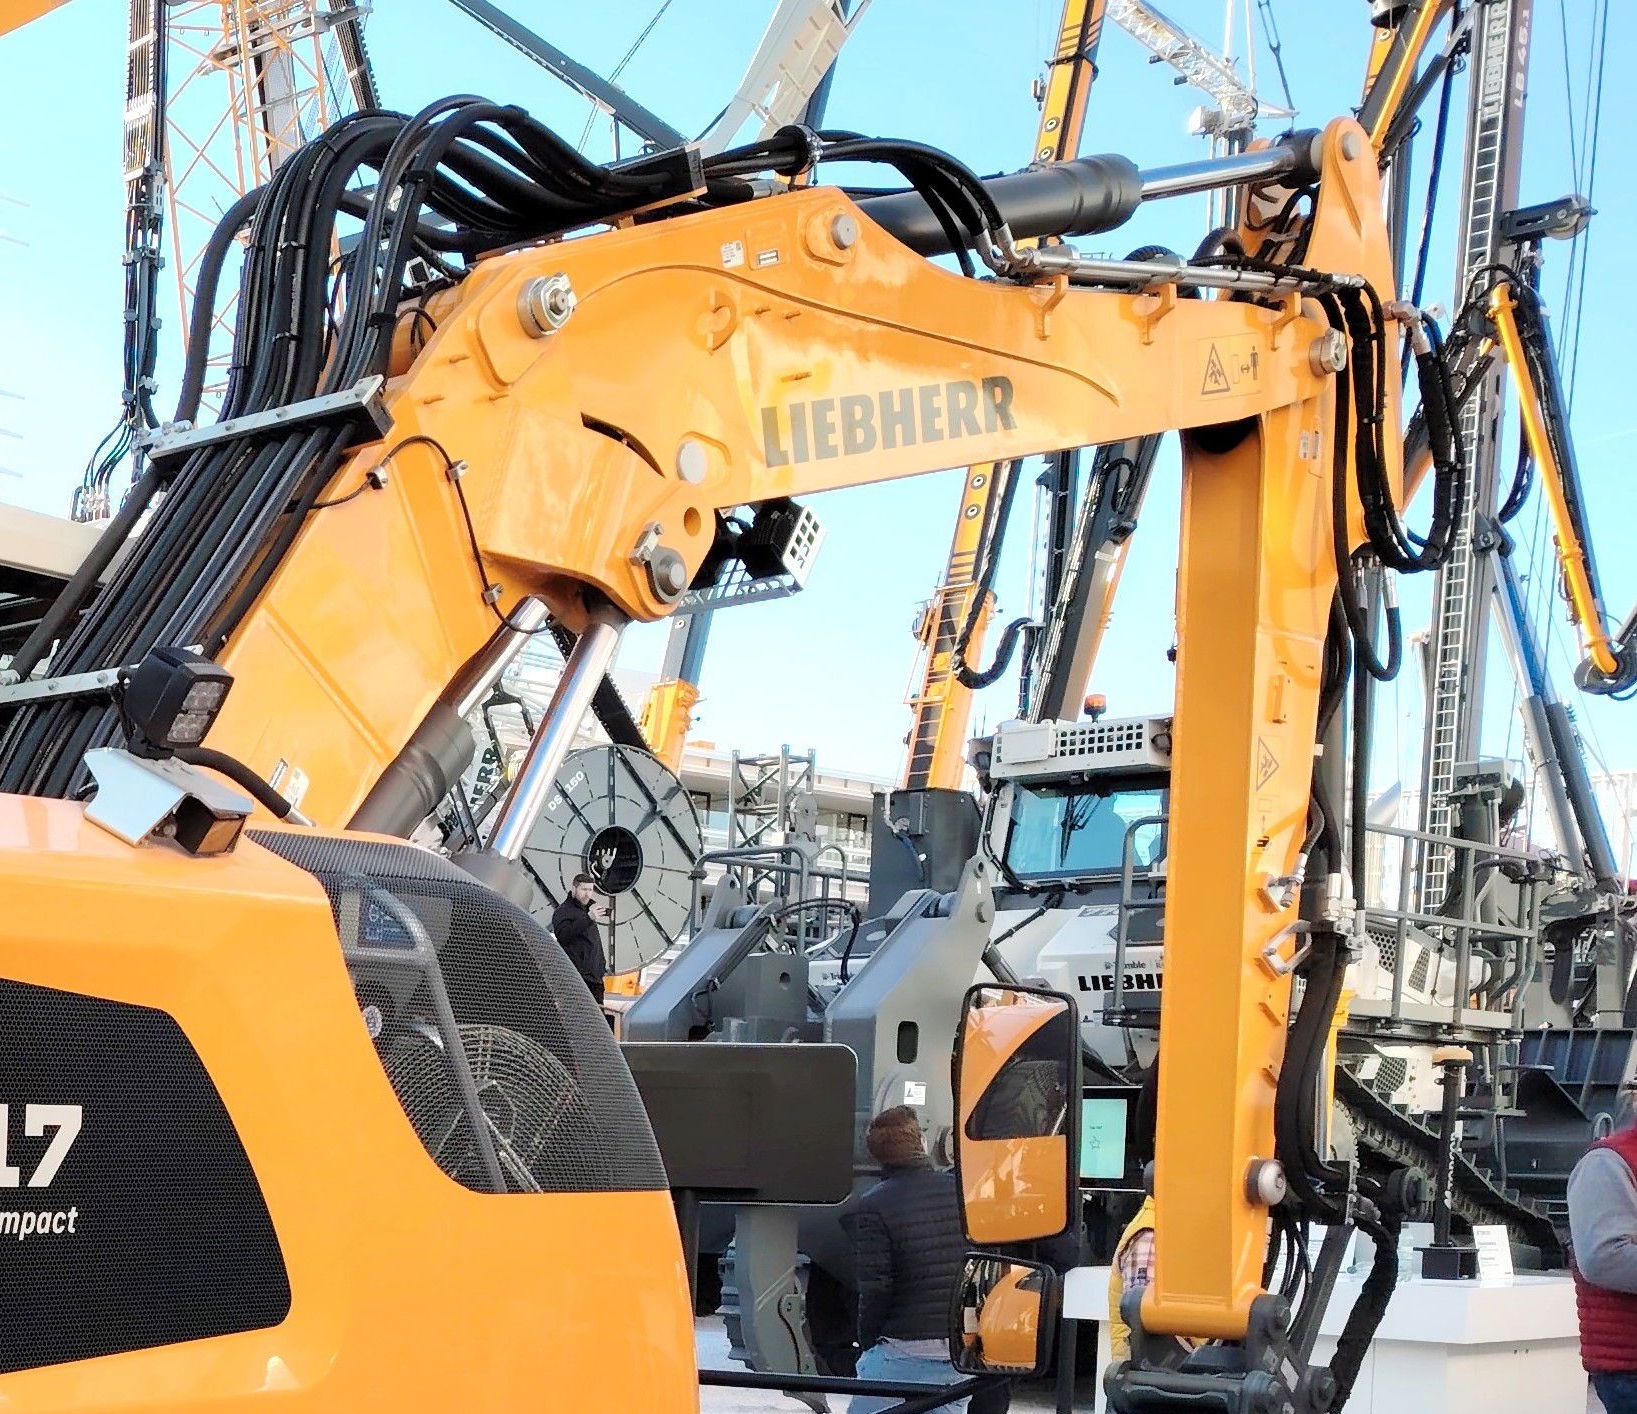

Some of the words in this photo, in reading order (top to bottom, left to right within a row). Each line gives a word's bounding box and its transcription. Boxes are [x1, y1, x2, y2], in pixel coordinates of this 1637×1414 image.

[1483, 1, 1509, 112] LIEBHERR
[1514, 71, 1525, 108] LB
[761, 376, 1017, 468] LIEBHERR
